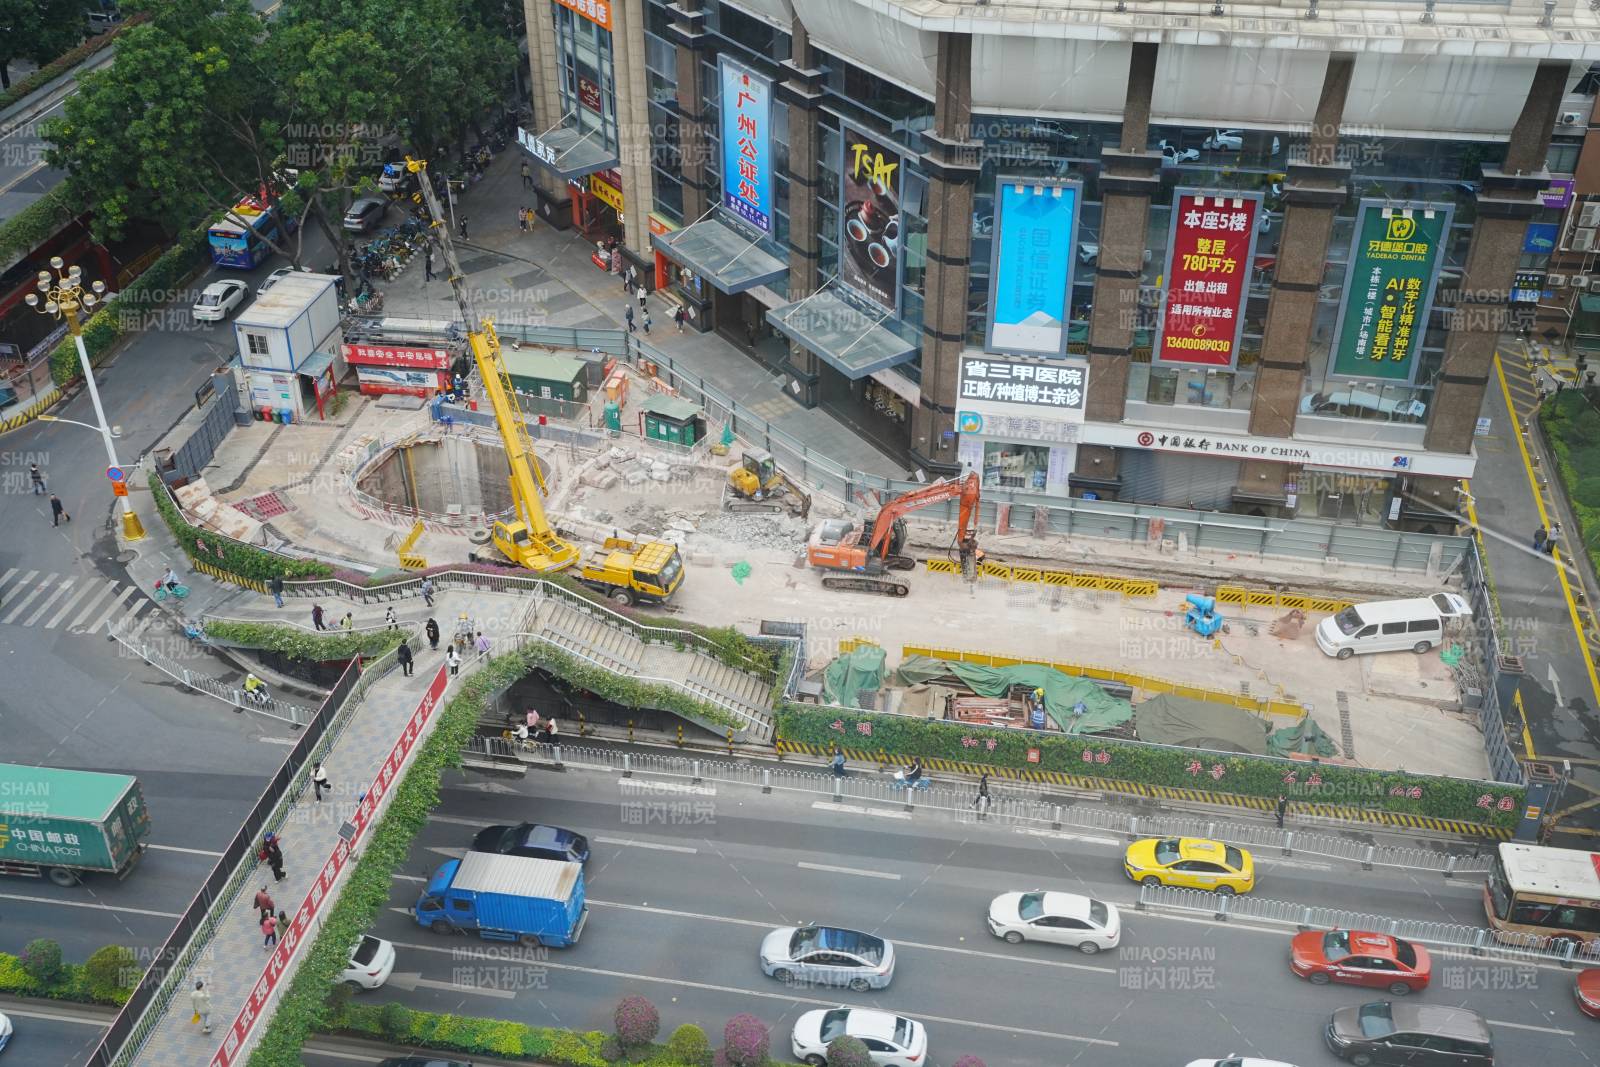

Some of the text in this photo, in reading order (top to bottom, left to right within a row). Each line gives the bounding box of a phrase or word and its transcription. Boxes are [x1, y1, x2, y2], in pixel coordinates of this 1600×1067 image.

[737, 91, 760, 206] 广州公证处
[1184, 210, 1248, 232] 本座5楼
[1197, 238, 1226, 255] 整层
[1183, 254, 1237, 274] 780平方
[1366, 252, 1426, 262] YADEBAO DENTAL
[1184, 280, 1228, 295] 出售出租
[1171, 303, 1233, 319] 适用所有业态
[1391, 277, 1423, 361] 数字化精准种牙
[965, 360, 1082, 386] 省三甲医院
[962, 379, 1081, 407] 正畸/种植博士亲诊
[1158, 434, 1211, 451] 中国银行
[1215, 442, 1311, 458] BANK OF CHINA
[11, 827, 81, 846] 中国邮政
[16, 842, 81, 857] CHINA POST
